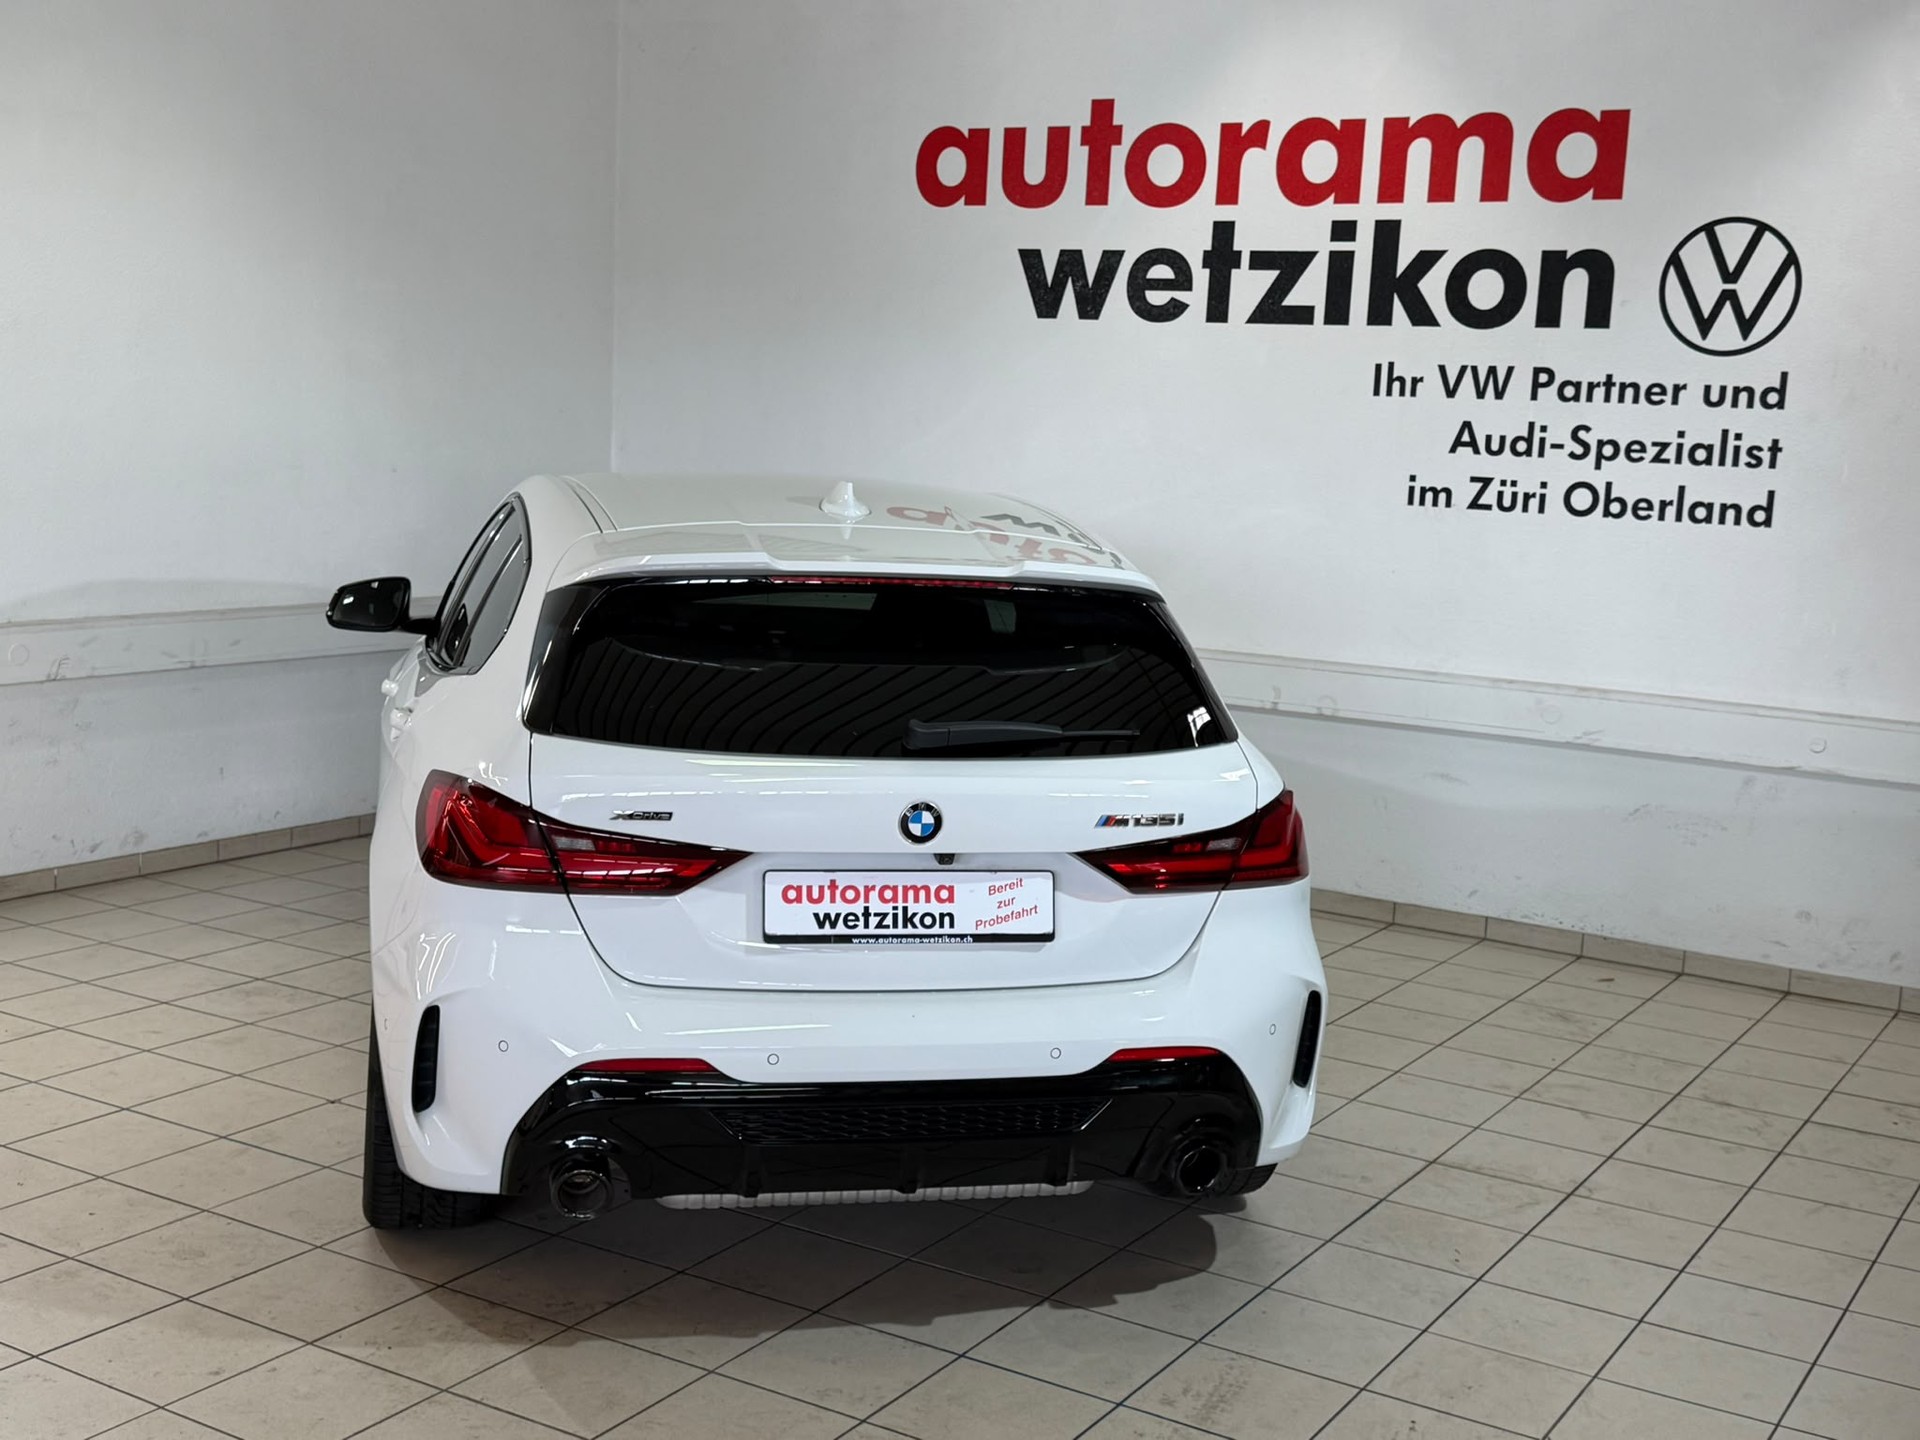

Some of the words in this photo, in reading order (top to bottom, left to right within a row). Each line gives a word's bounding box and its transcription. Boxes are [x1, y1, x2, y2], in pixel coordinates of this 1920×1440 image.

[915, 98, 1632, 209] autorama
[1017, 219, 1615, 330] wetzikon
[1658, 216, 1803, 357] VW
[1372, 361, 1424, 398] Ihr
[1437, 364, 1515, 401] VW
[1530, 366, 1688, 406] Partner
[1702, 371, 1789, 410] und
[1448, 420, 1783, 471] Audi-Spezialist
[1407, 474, 1453, 509] im
[1466, 476, 1548, 515] Züri
[1563, 481, 1776, 529] Oberland
[781, 879, 955, 905] autorama
[988, 878, 1024, 896] Bereit
[996, 895, 1016, 909] zur
[812, 905, 955, 930] wetzikon
[975, 904, 1039, 930] Probefahrt
[851, 935, 973, 944] www.autorama-wetzikon.ch
